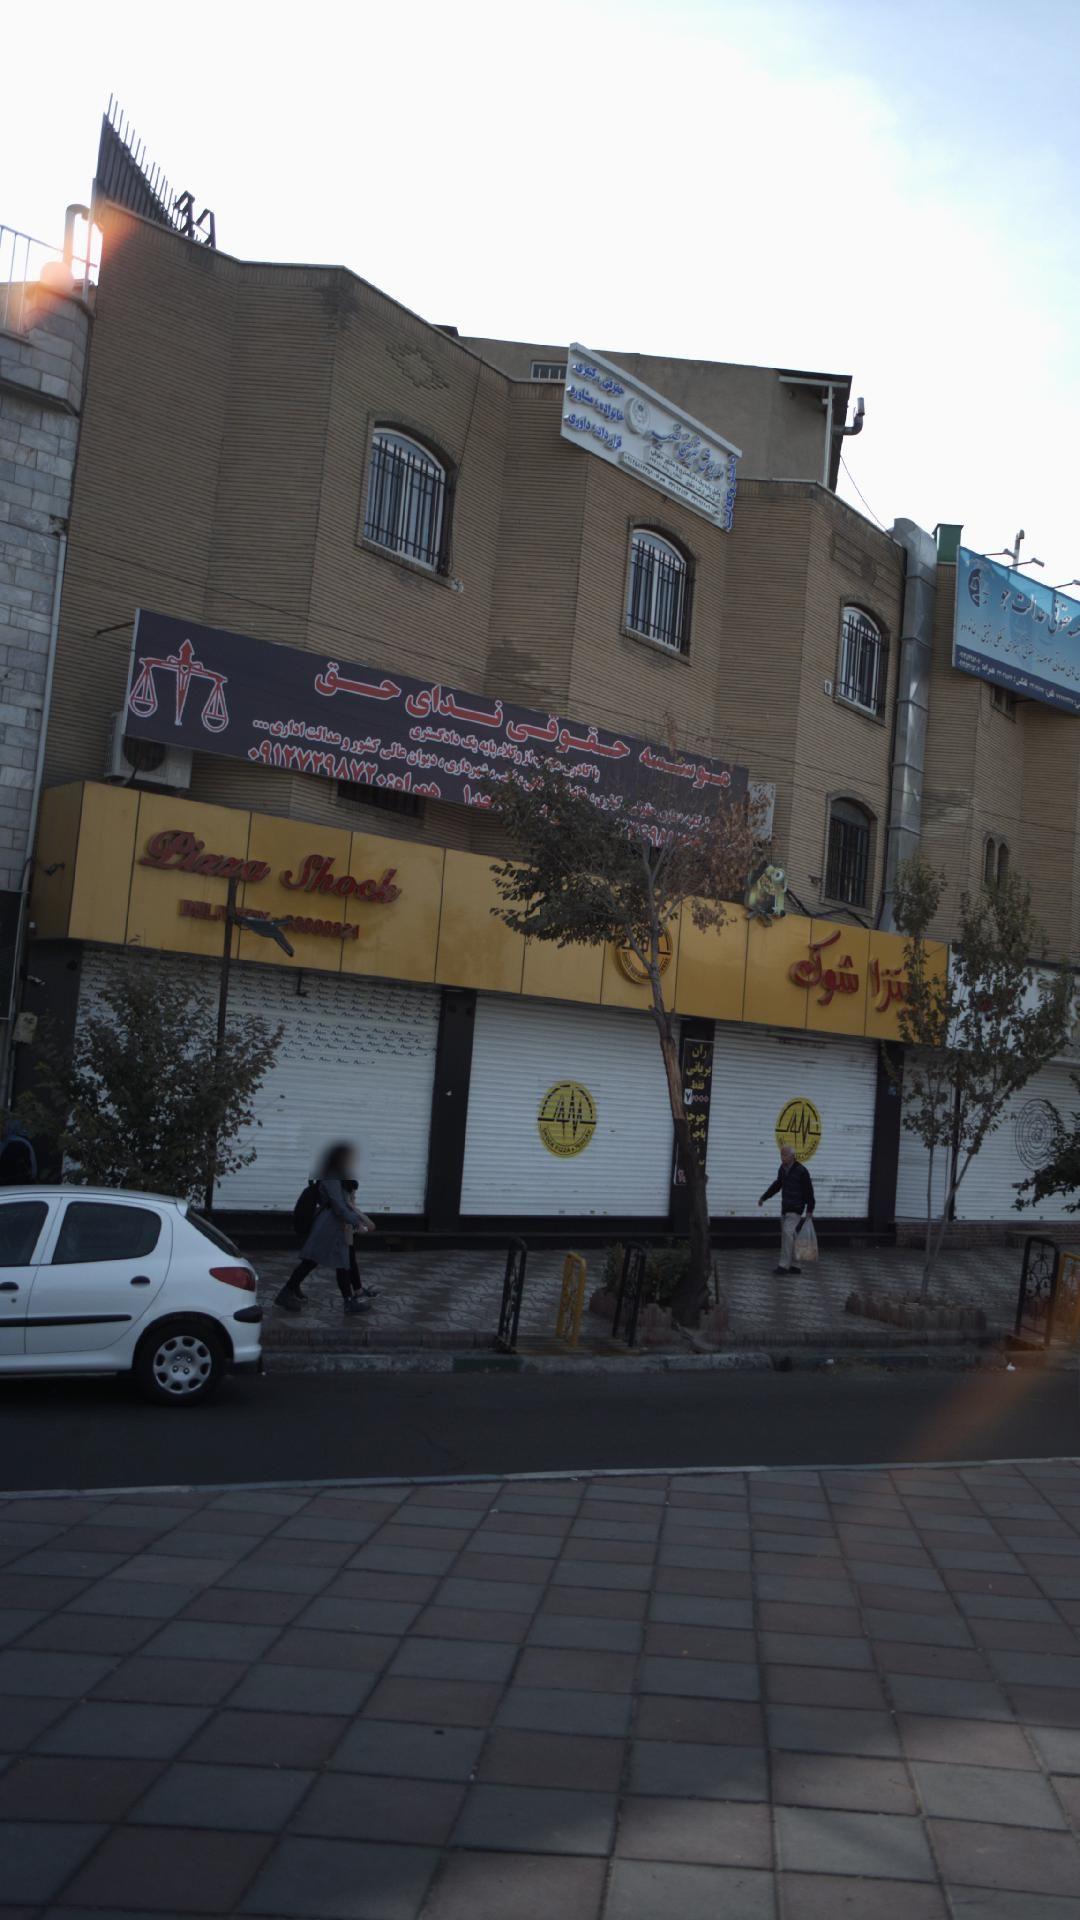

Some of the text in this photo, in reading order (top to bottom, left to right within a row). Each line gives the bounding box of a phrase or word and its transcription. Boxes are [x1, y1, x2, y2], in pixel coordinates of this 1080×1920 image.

[314, 661, 402, 701] حق
[405, 684, 504, 728] ندای
[269, 719, 306, 740] اداری
[305, 725, 341, 746] عدالت
[409, 725, 461, 747] دادگستری
[505, 712, 631, 759] حقوقی
[340, 736, 351, 752] و
[350, 736, 381, 756] کشور
[380, 742, 407, 761] عالی
[461, 735, 478, 751] یک
[479, 739, 497, 760] پایه
[406, 749, 438, 769] دیوان
[139, 828, 402, 905] Pizza Shock
[789, 930, 860, 1006] شوک
